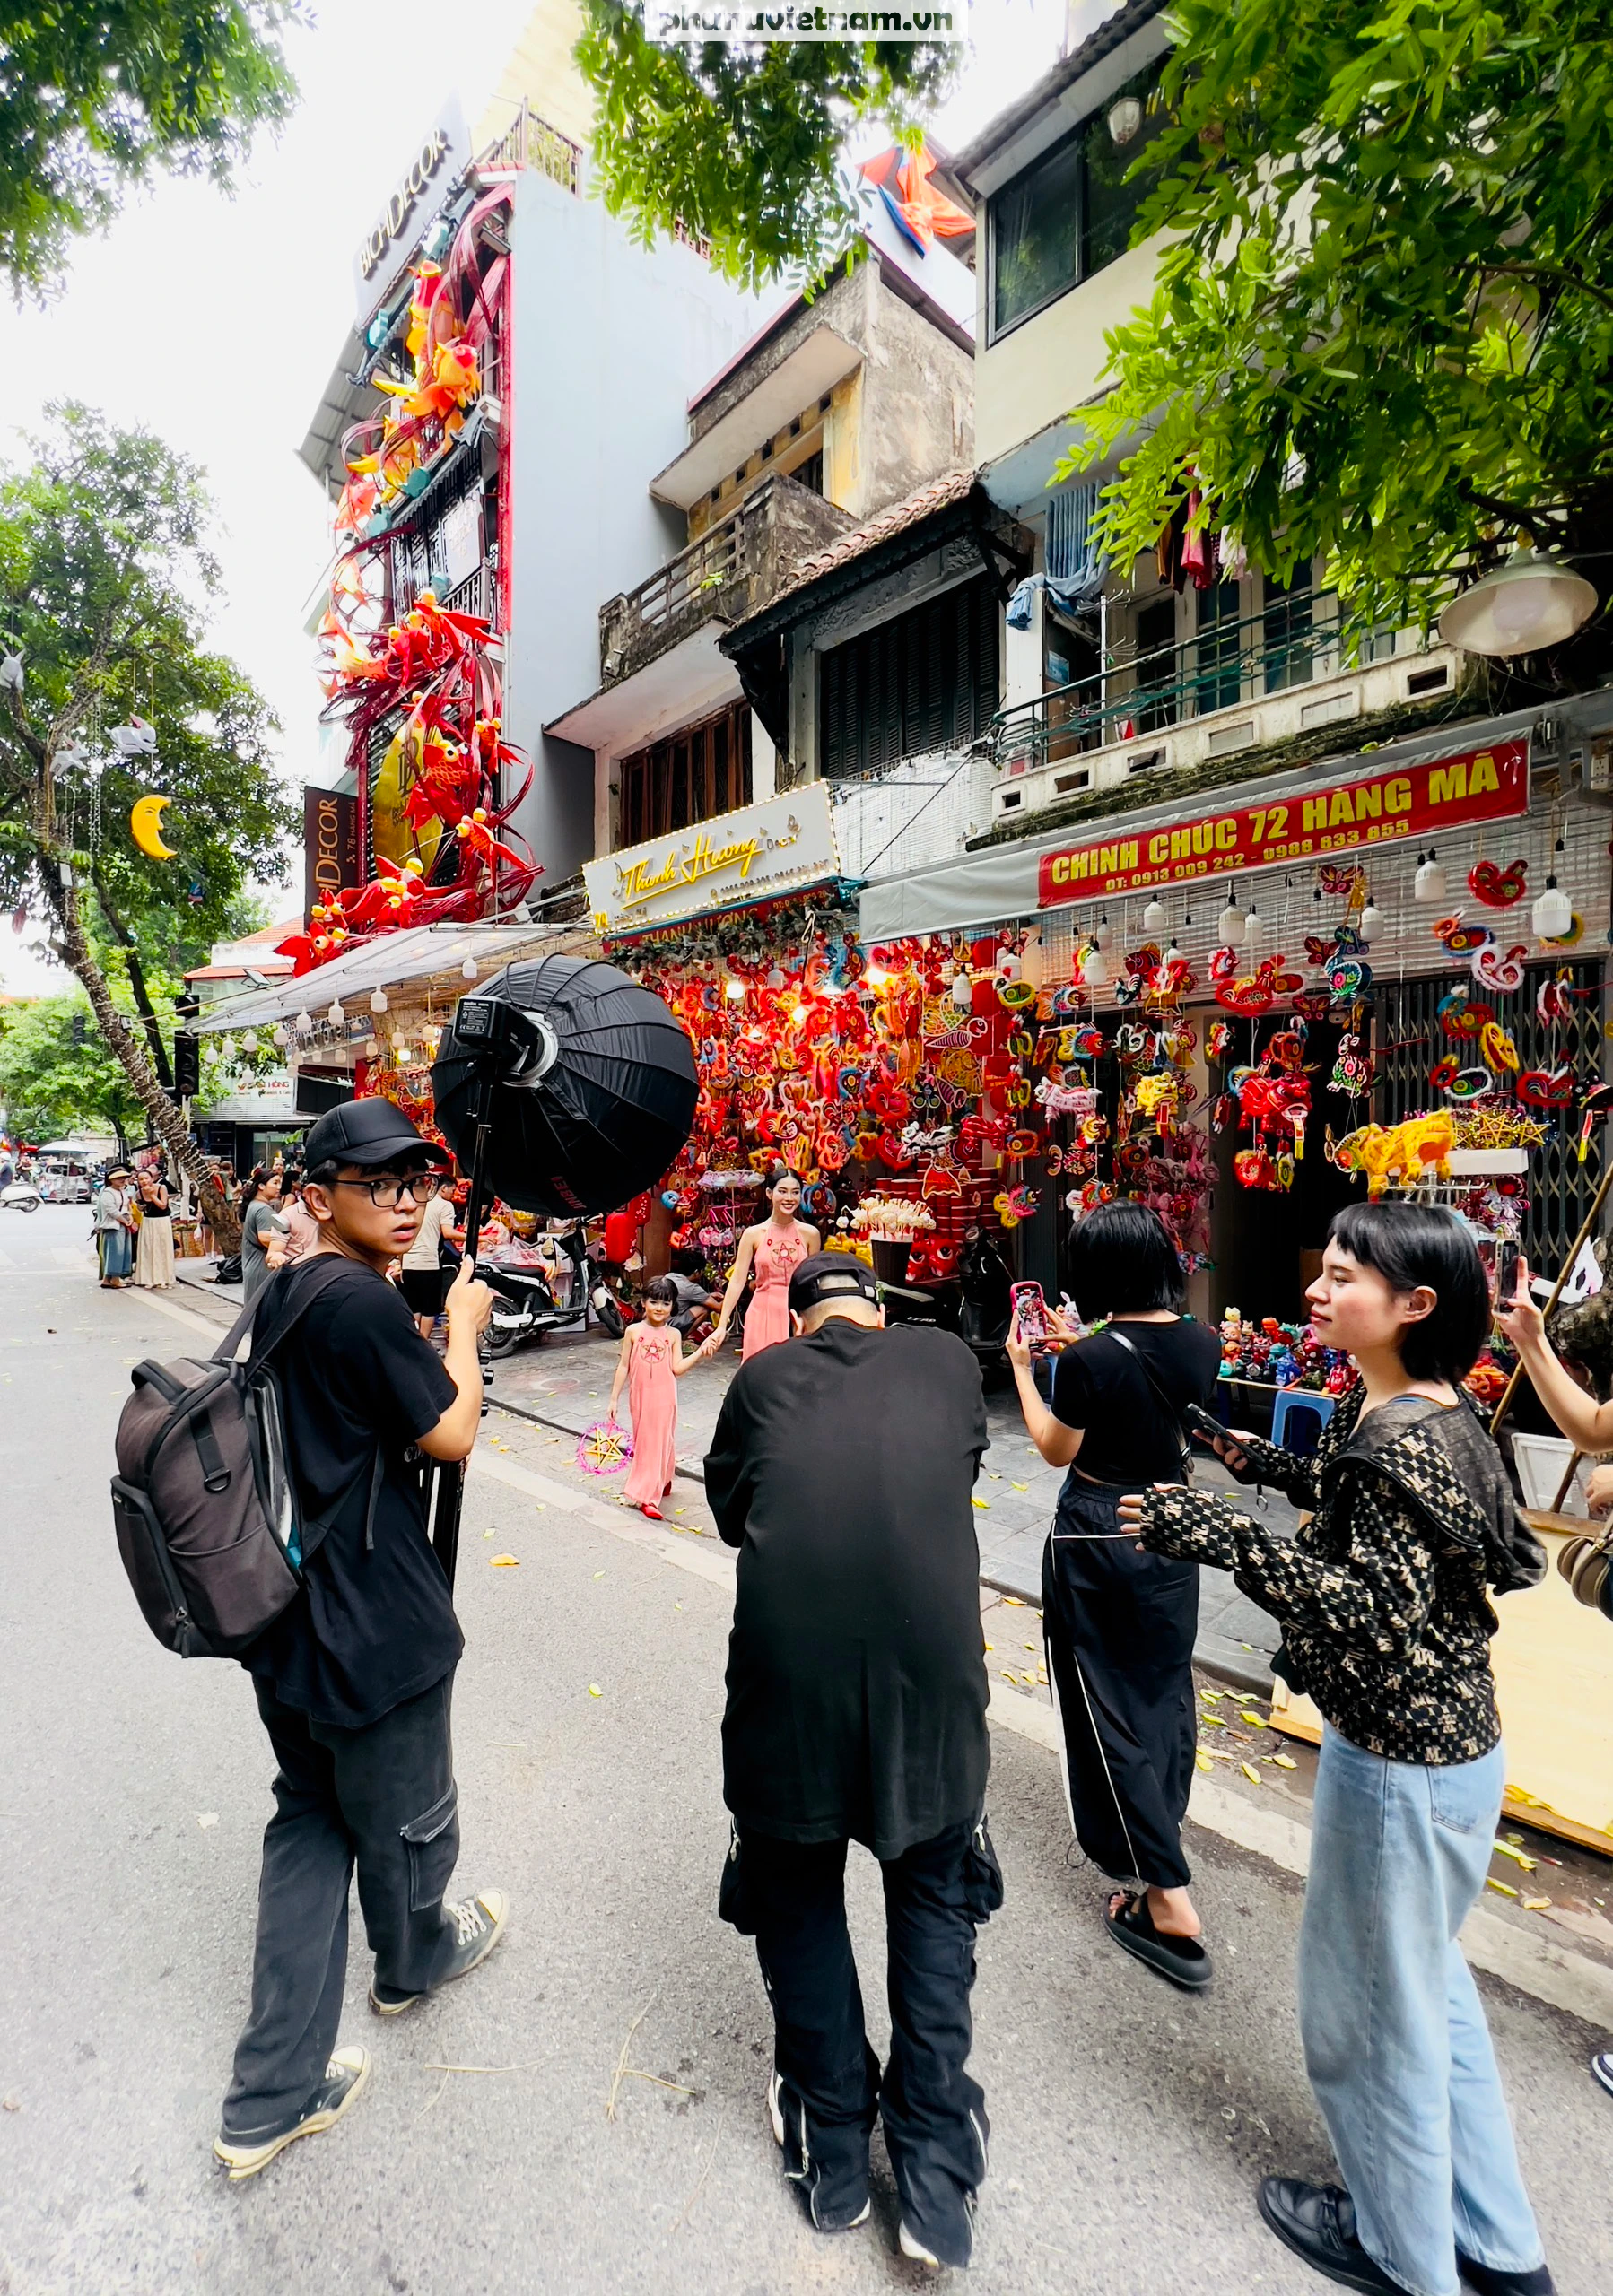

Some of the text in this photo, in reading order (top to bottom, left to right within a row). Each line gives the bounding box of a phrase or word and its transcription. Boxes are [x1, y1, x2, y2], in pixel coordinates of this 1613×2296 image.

[347, 838, 356, 850] 78
[1051, 752, 1500, 884] CHINH CHÚC 72 HÀNG MÃ
[623, 851, 677, 900] Thanh
[1131, 867, 1170, 886] 0913
[1174, 860, 1208, 878] 009
[1212, 853, 1245, 871] 242
[1263, 839, 1313, 861] 0988
[1320, 830, 1360, 849] 833
[1367, 819, 1409, 840] 855
